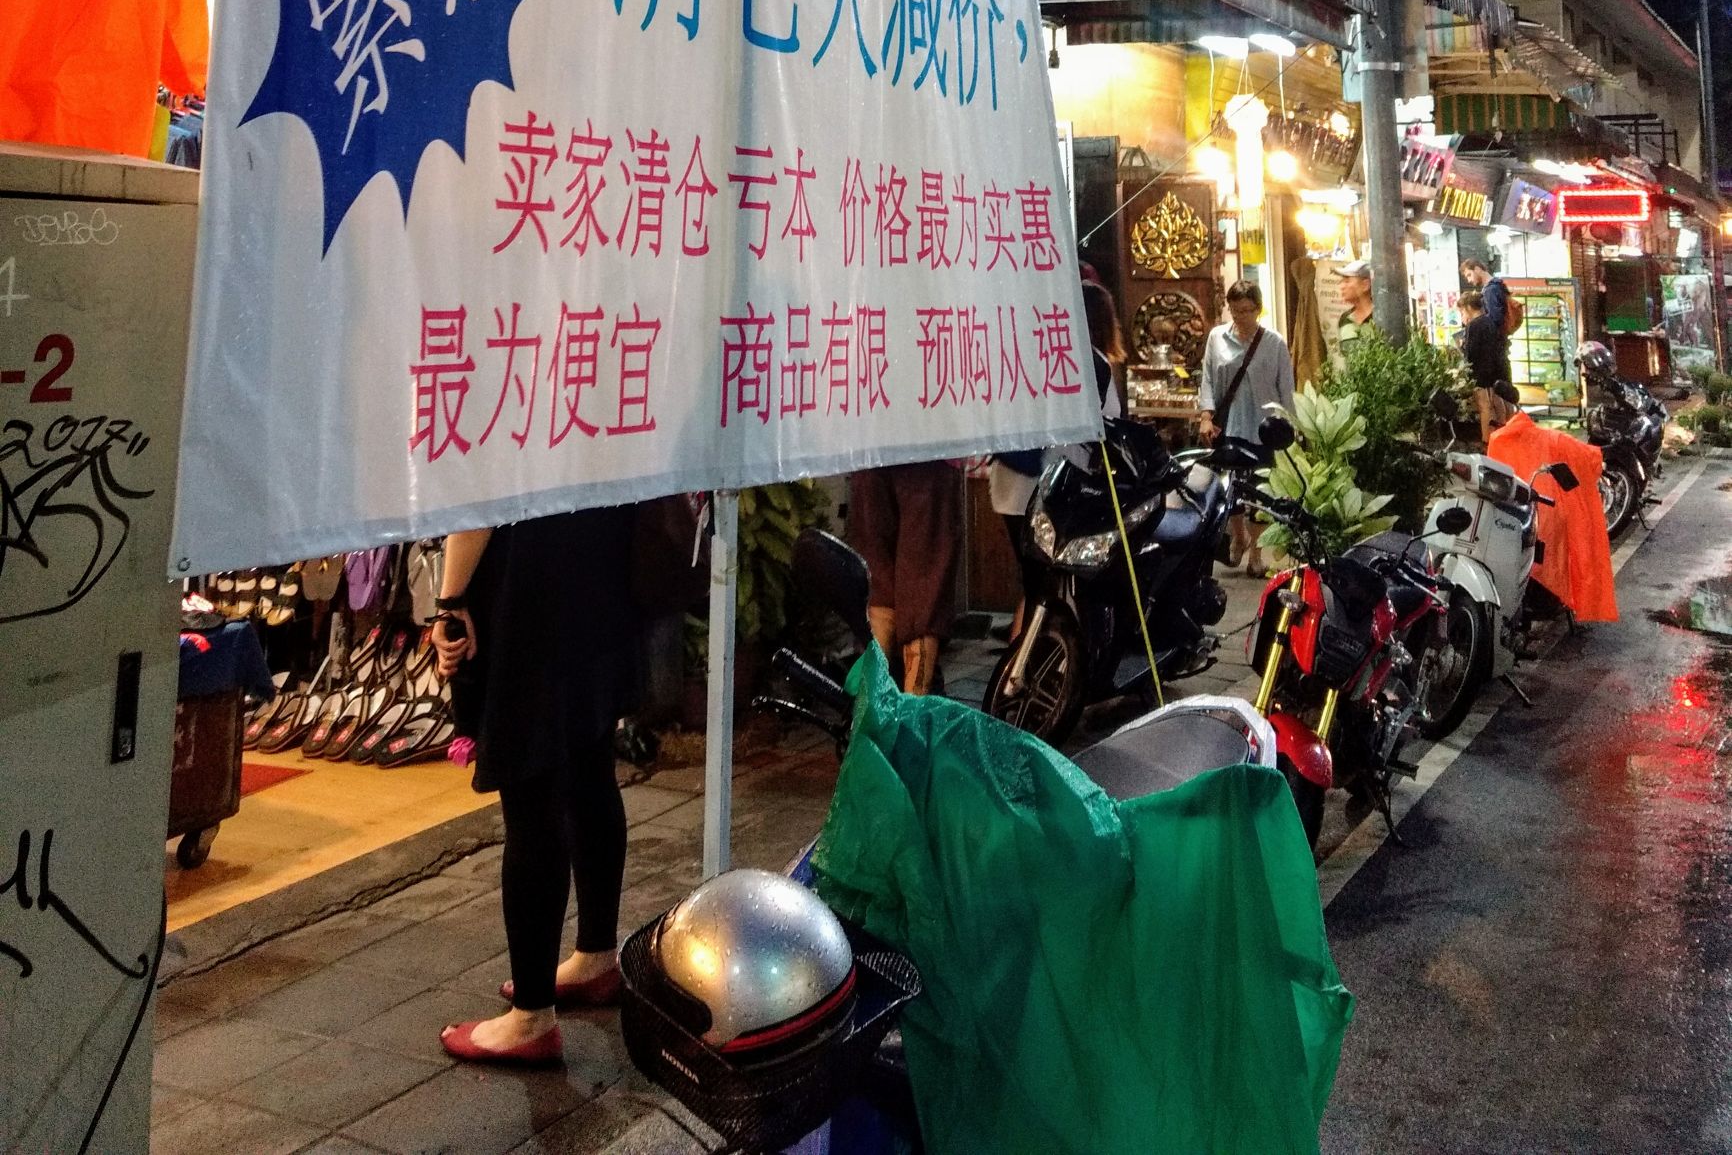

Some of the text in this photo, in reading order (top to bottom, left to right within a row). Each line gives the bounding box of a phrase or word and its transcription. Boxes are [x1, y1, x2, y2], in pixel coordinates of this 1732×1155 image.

[493, 110, 1061, 272] 卖家清仓亏本 价格最为实惠
[408, 302, 1082, 463] 最为便宜 商品有限 预购从速
[661, 1048, 700, 1084] HONDA
